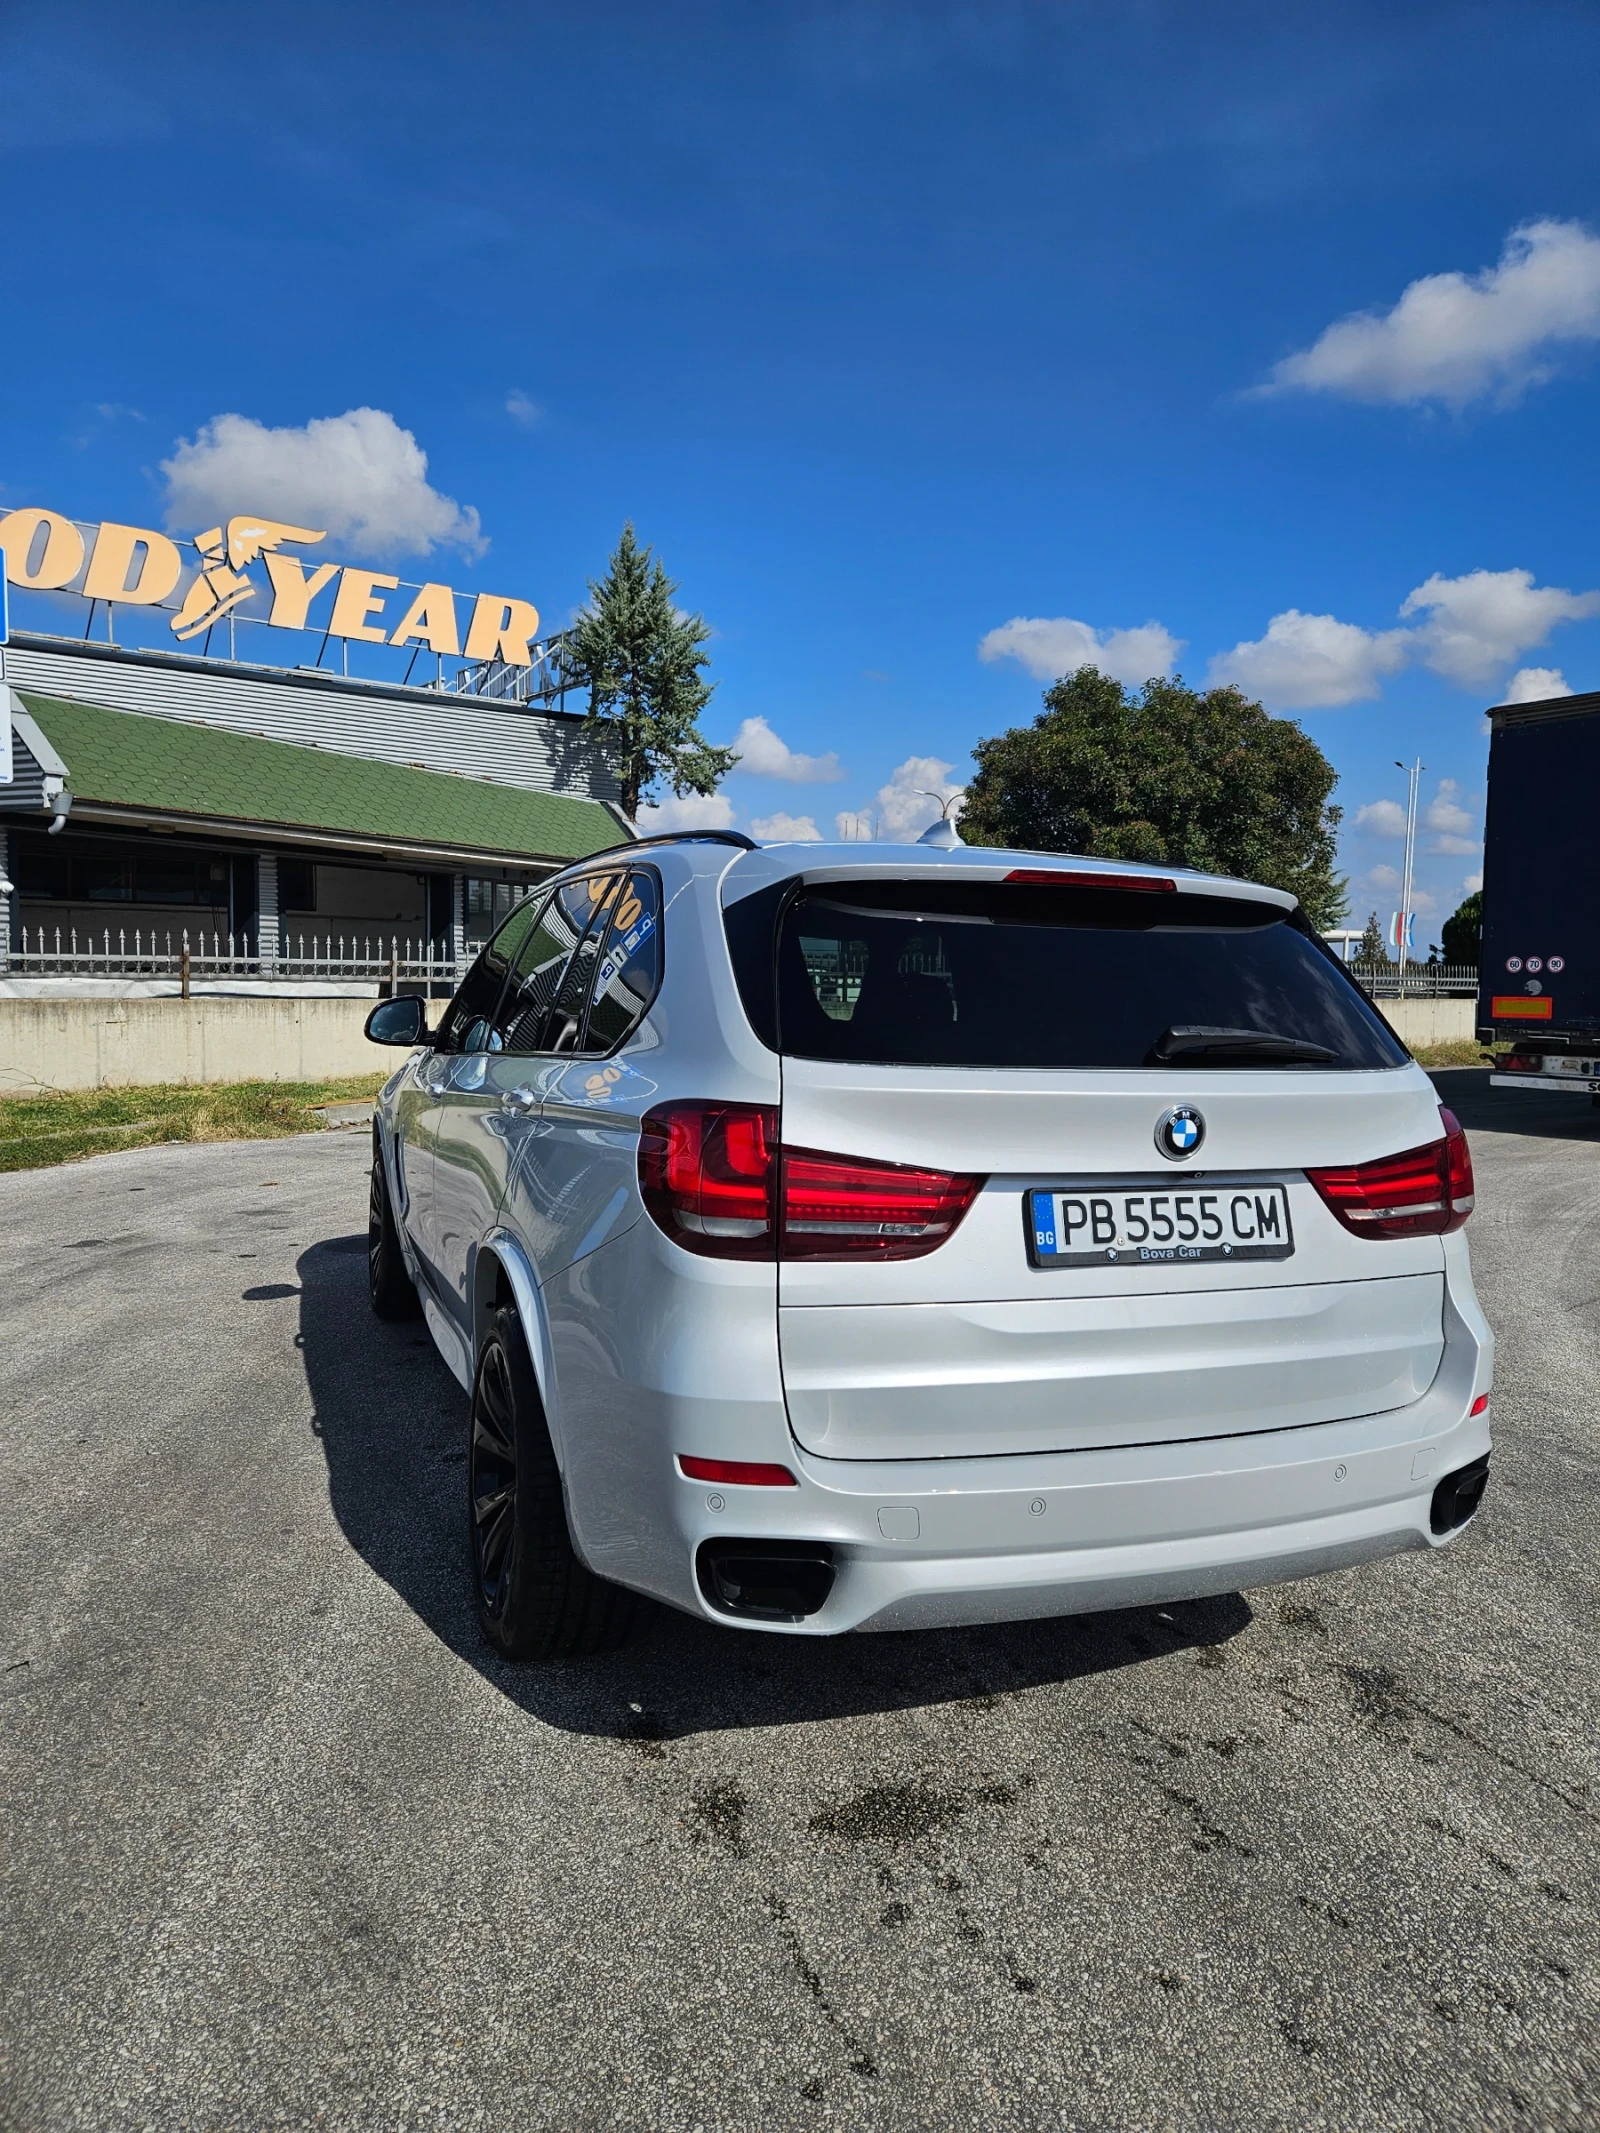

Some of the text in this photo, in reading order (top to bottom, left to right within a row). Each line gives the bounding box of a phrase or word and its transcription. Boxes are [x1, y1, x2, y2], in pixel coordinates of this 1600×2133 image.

[263, 552, 540, 667] YEAR
[1509, 960, 1520, 969] 60
[1529, 960, 1540, 969] 70
[1551, 960, 1562, 968] 90
[1588, 1082, 1600, 1092] S
[1125, 1196, 1223, 1242] 5555
[1230, 1195, 1281, 1240] CM
[1037, 1231, 1054, 1246] BG
[1140, 1245, 1202, 1260] Bova Car
